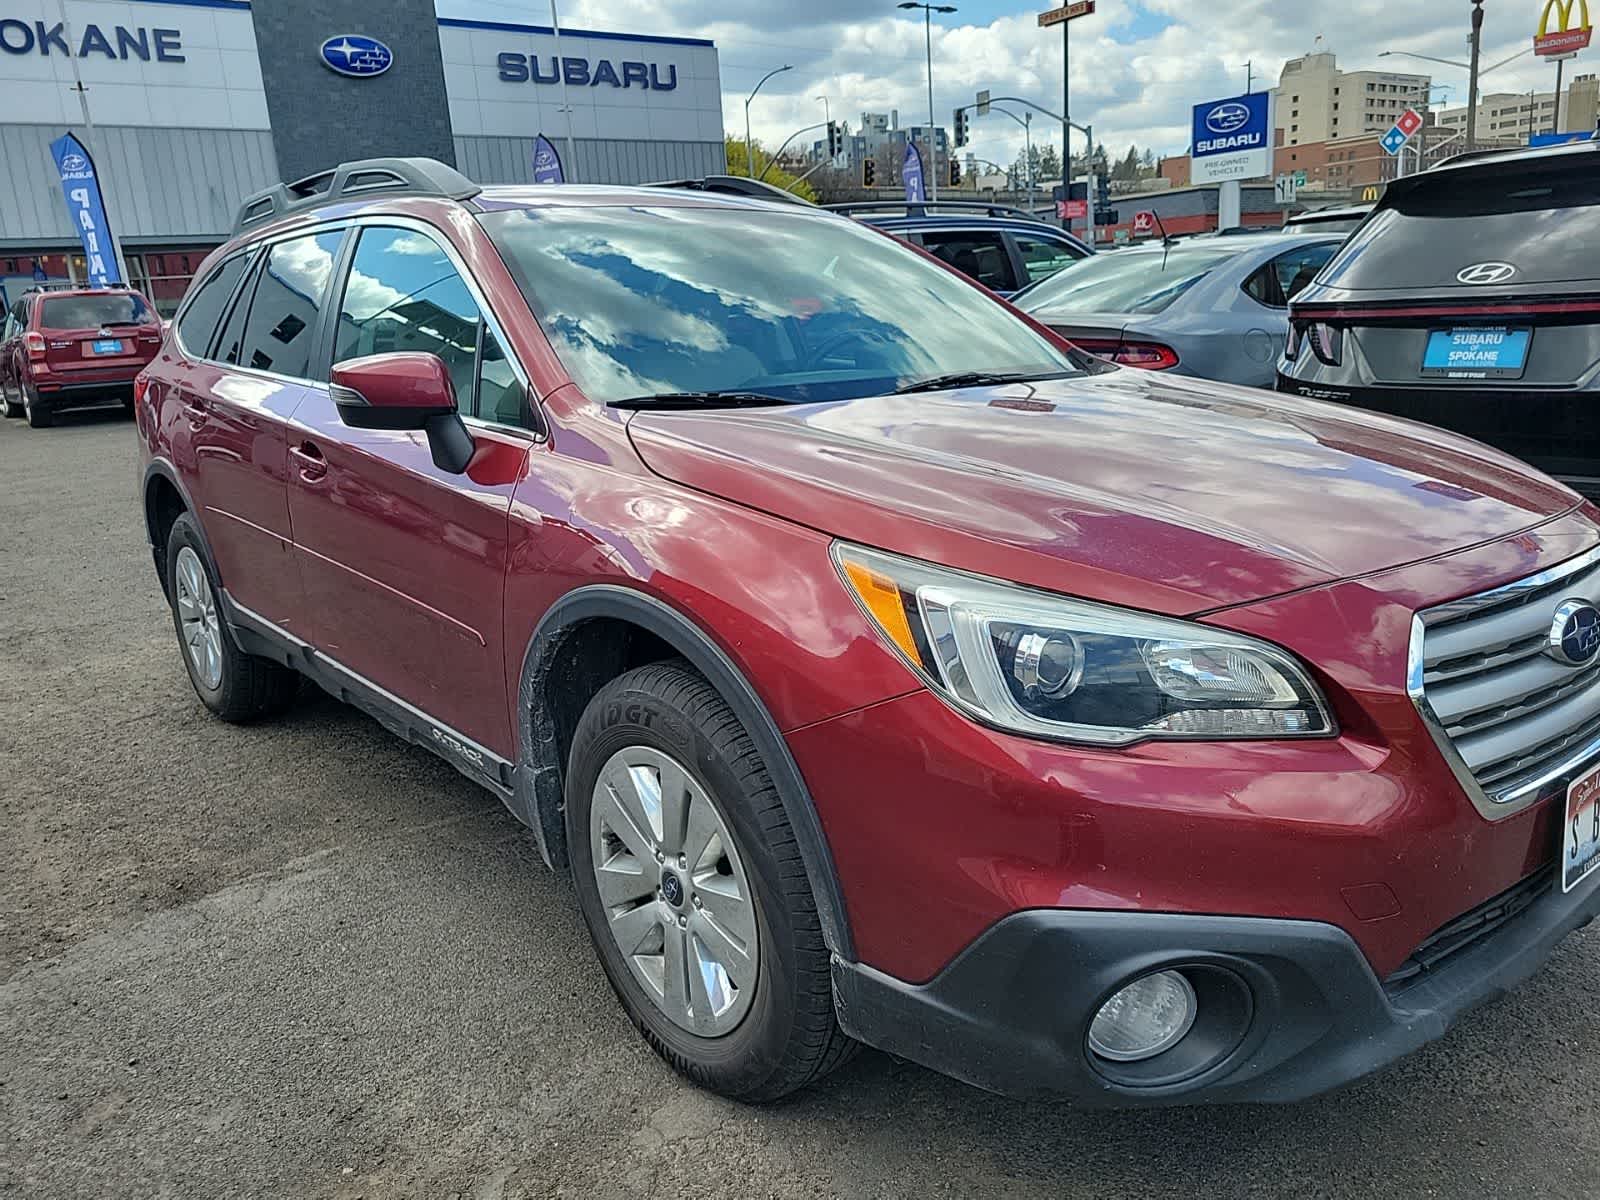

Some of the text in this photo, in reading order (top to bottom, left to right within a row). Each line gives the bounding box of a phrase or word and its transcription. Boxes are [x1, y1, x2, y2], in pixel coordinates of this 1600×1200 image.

[498, 52, 677, 91] SUBARU
[1196, 132, 1261, 153] SUBARU
[1204, 157, 1249, 169] PRE-OWNED
[1208, 166, 1245, 177] VEHICLES
[1452, 333, 1504, 345] SUBARU
[1448, 351, 1500, 361] SPOKANE
